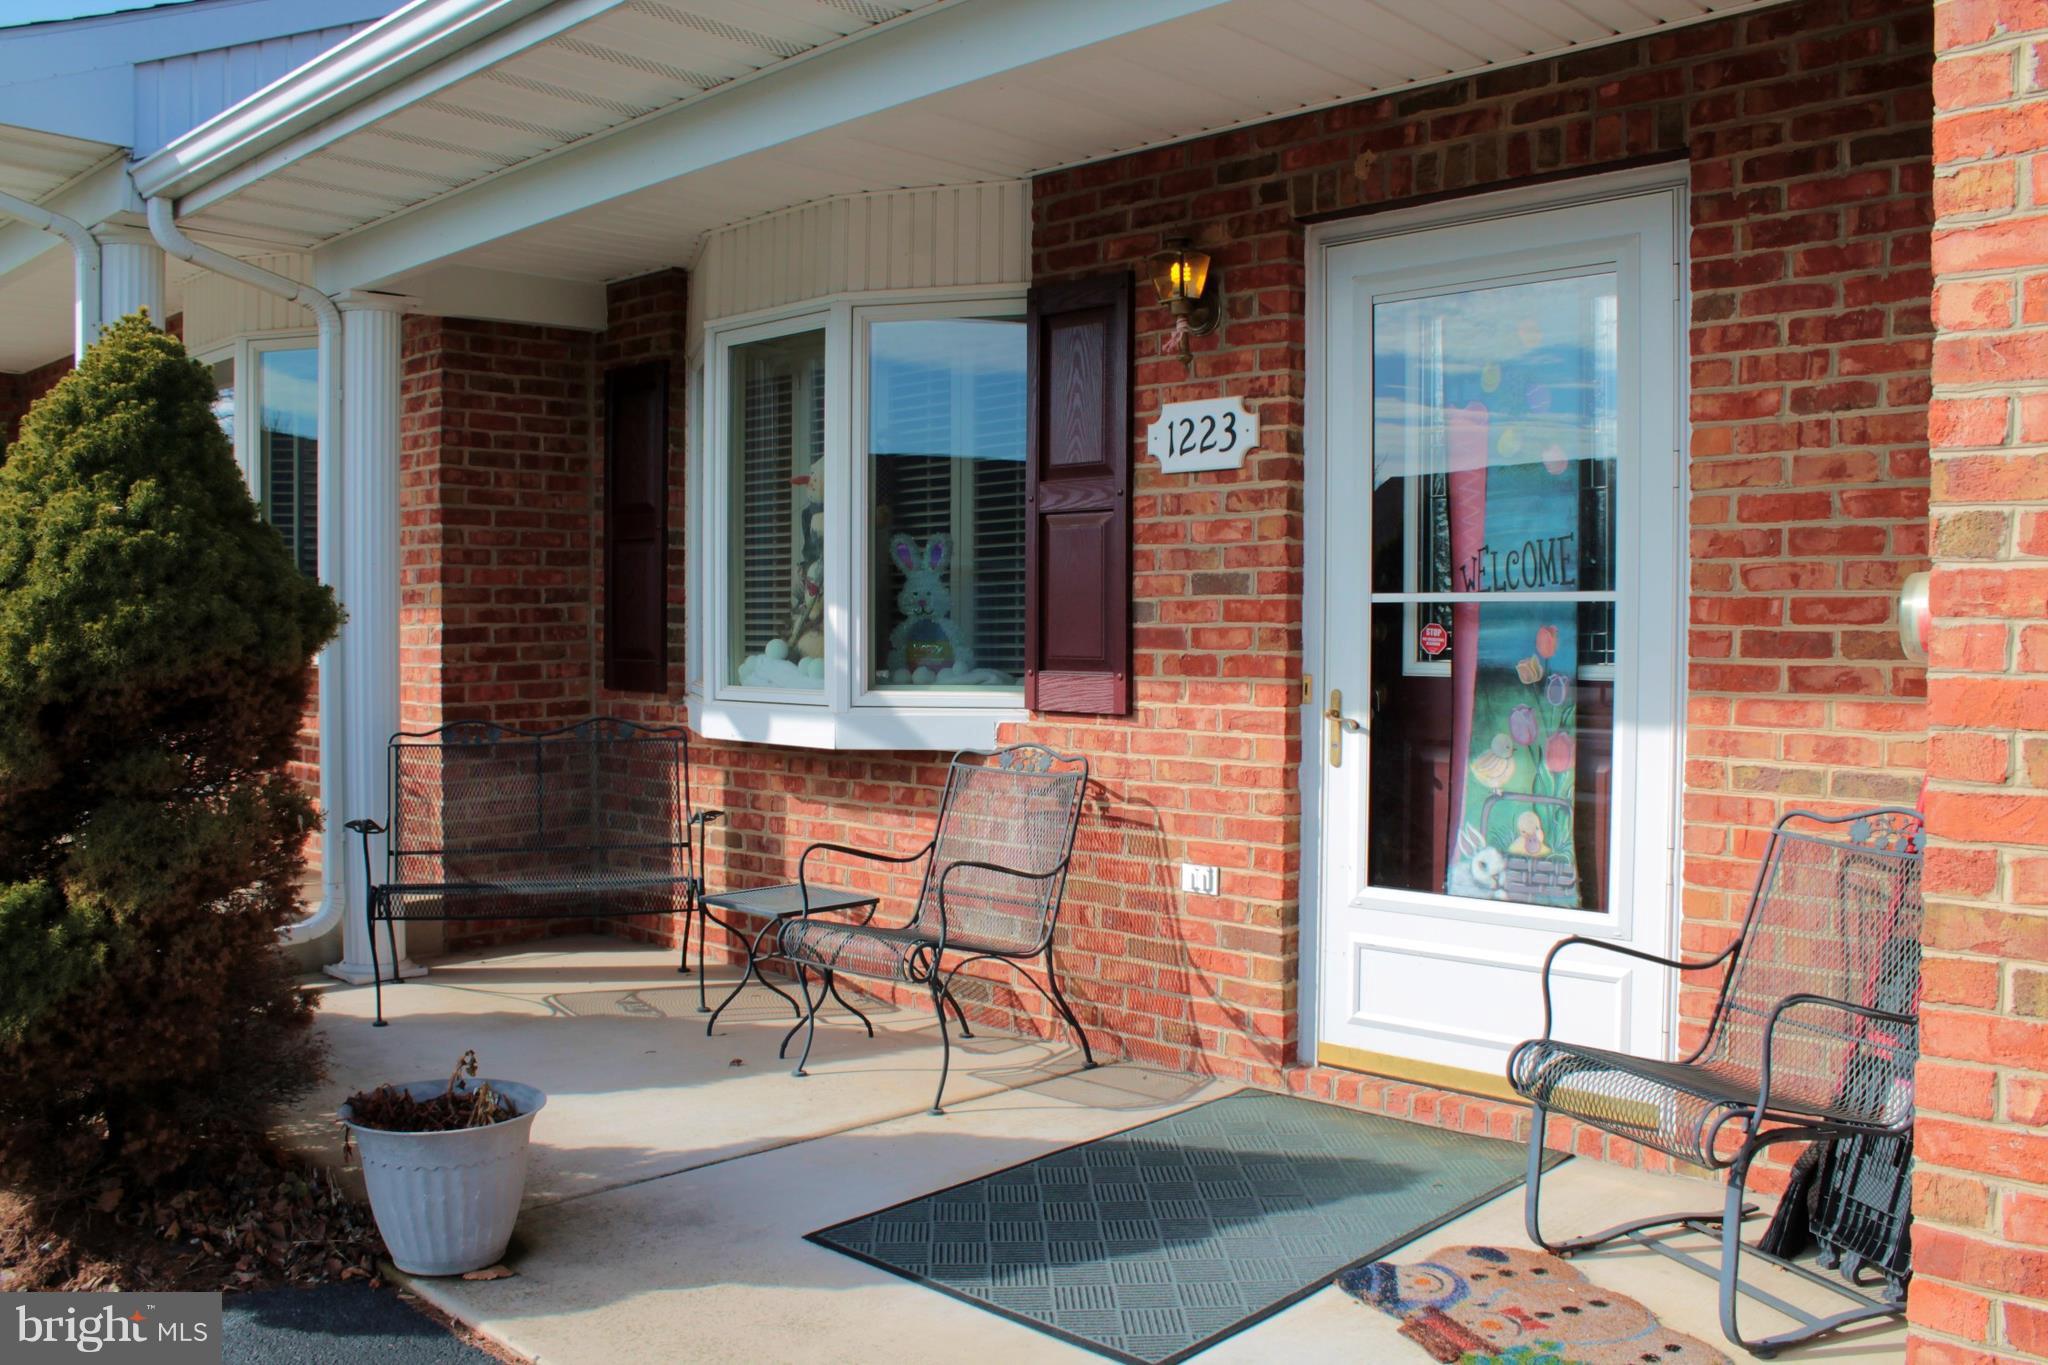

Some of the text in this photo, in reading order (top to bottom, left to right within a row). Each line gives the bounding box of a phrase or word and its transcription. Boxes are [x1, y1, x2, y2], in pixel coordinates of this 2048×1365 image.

[1168, 411, 1237, 458] 1223
[1459, 532, 1575, 592] WELCOME
[1425, 628, 1442, 637] STOP
